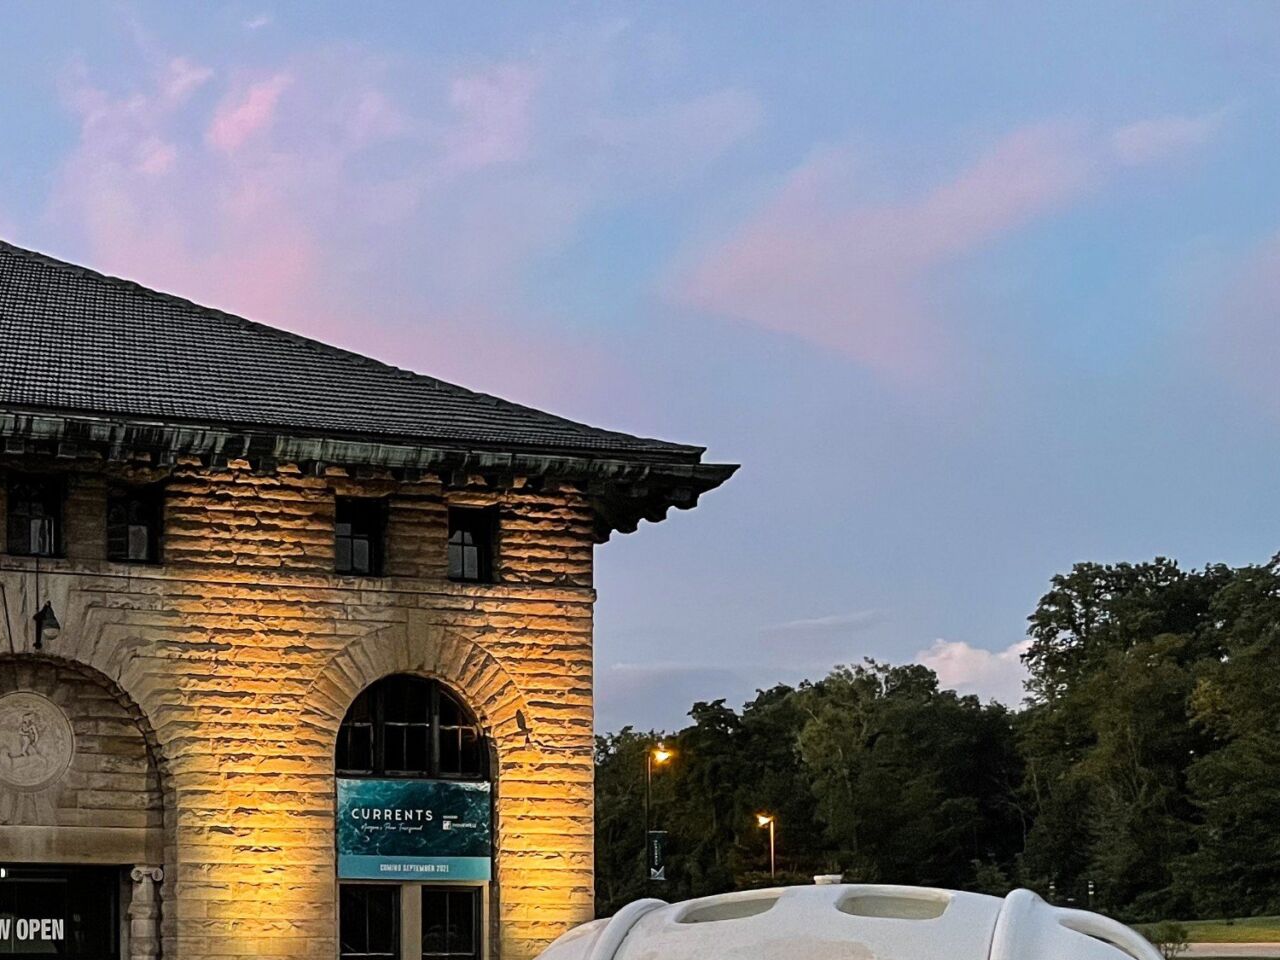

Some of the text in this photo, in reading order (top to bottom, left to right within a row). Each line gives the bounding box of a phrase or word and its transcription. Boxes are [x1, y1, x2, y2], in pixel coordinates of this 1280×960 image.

[351, 808, 433, 821] CURRENTS
[402, 864, 436, 872] SEPTEMBER
[16, 918, 64, 940] OPEN
